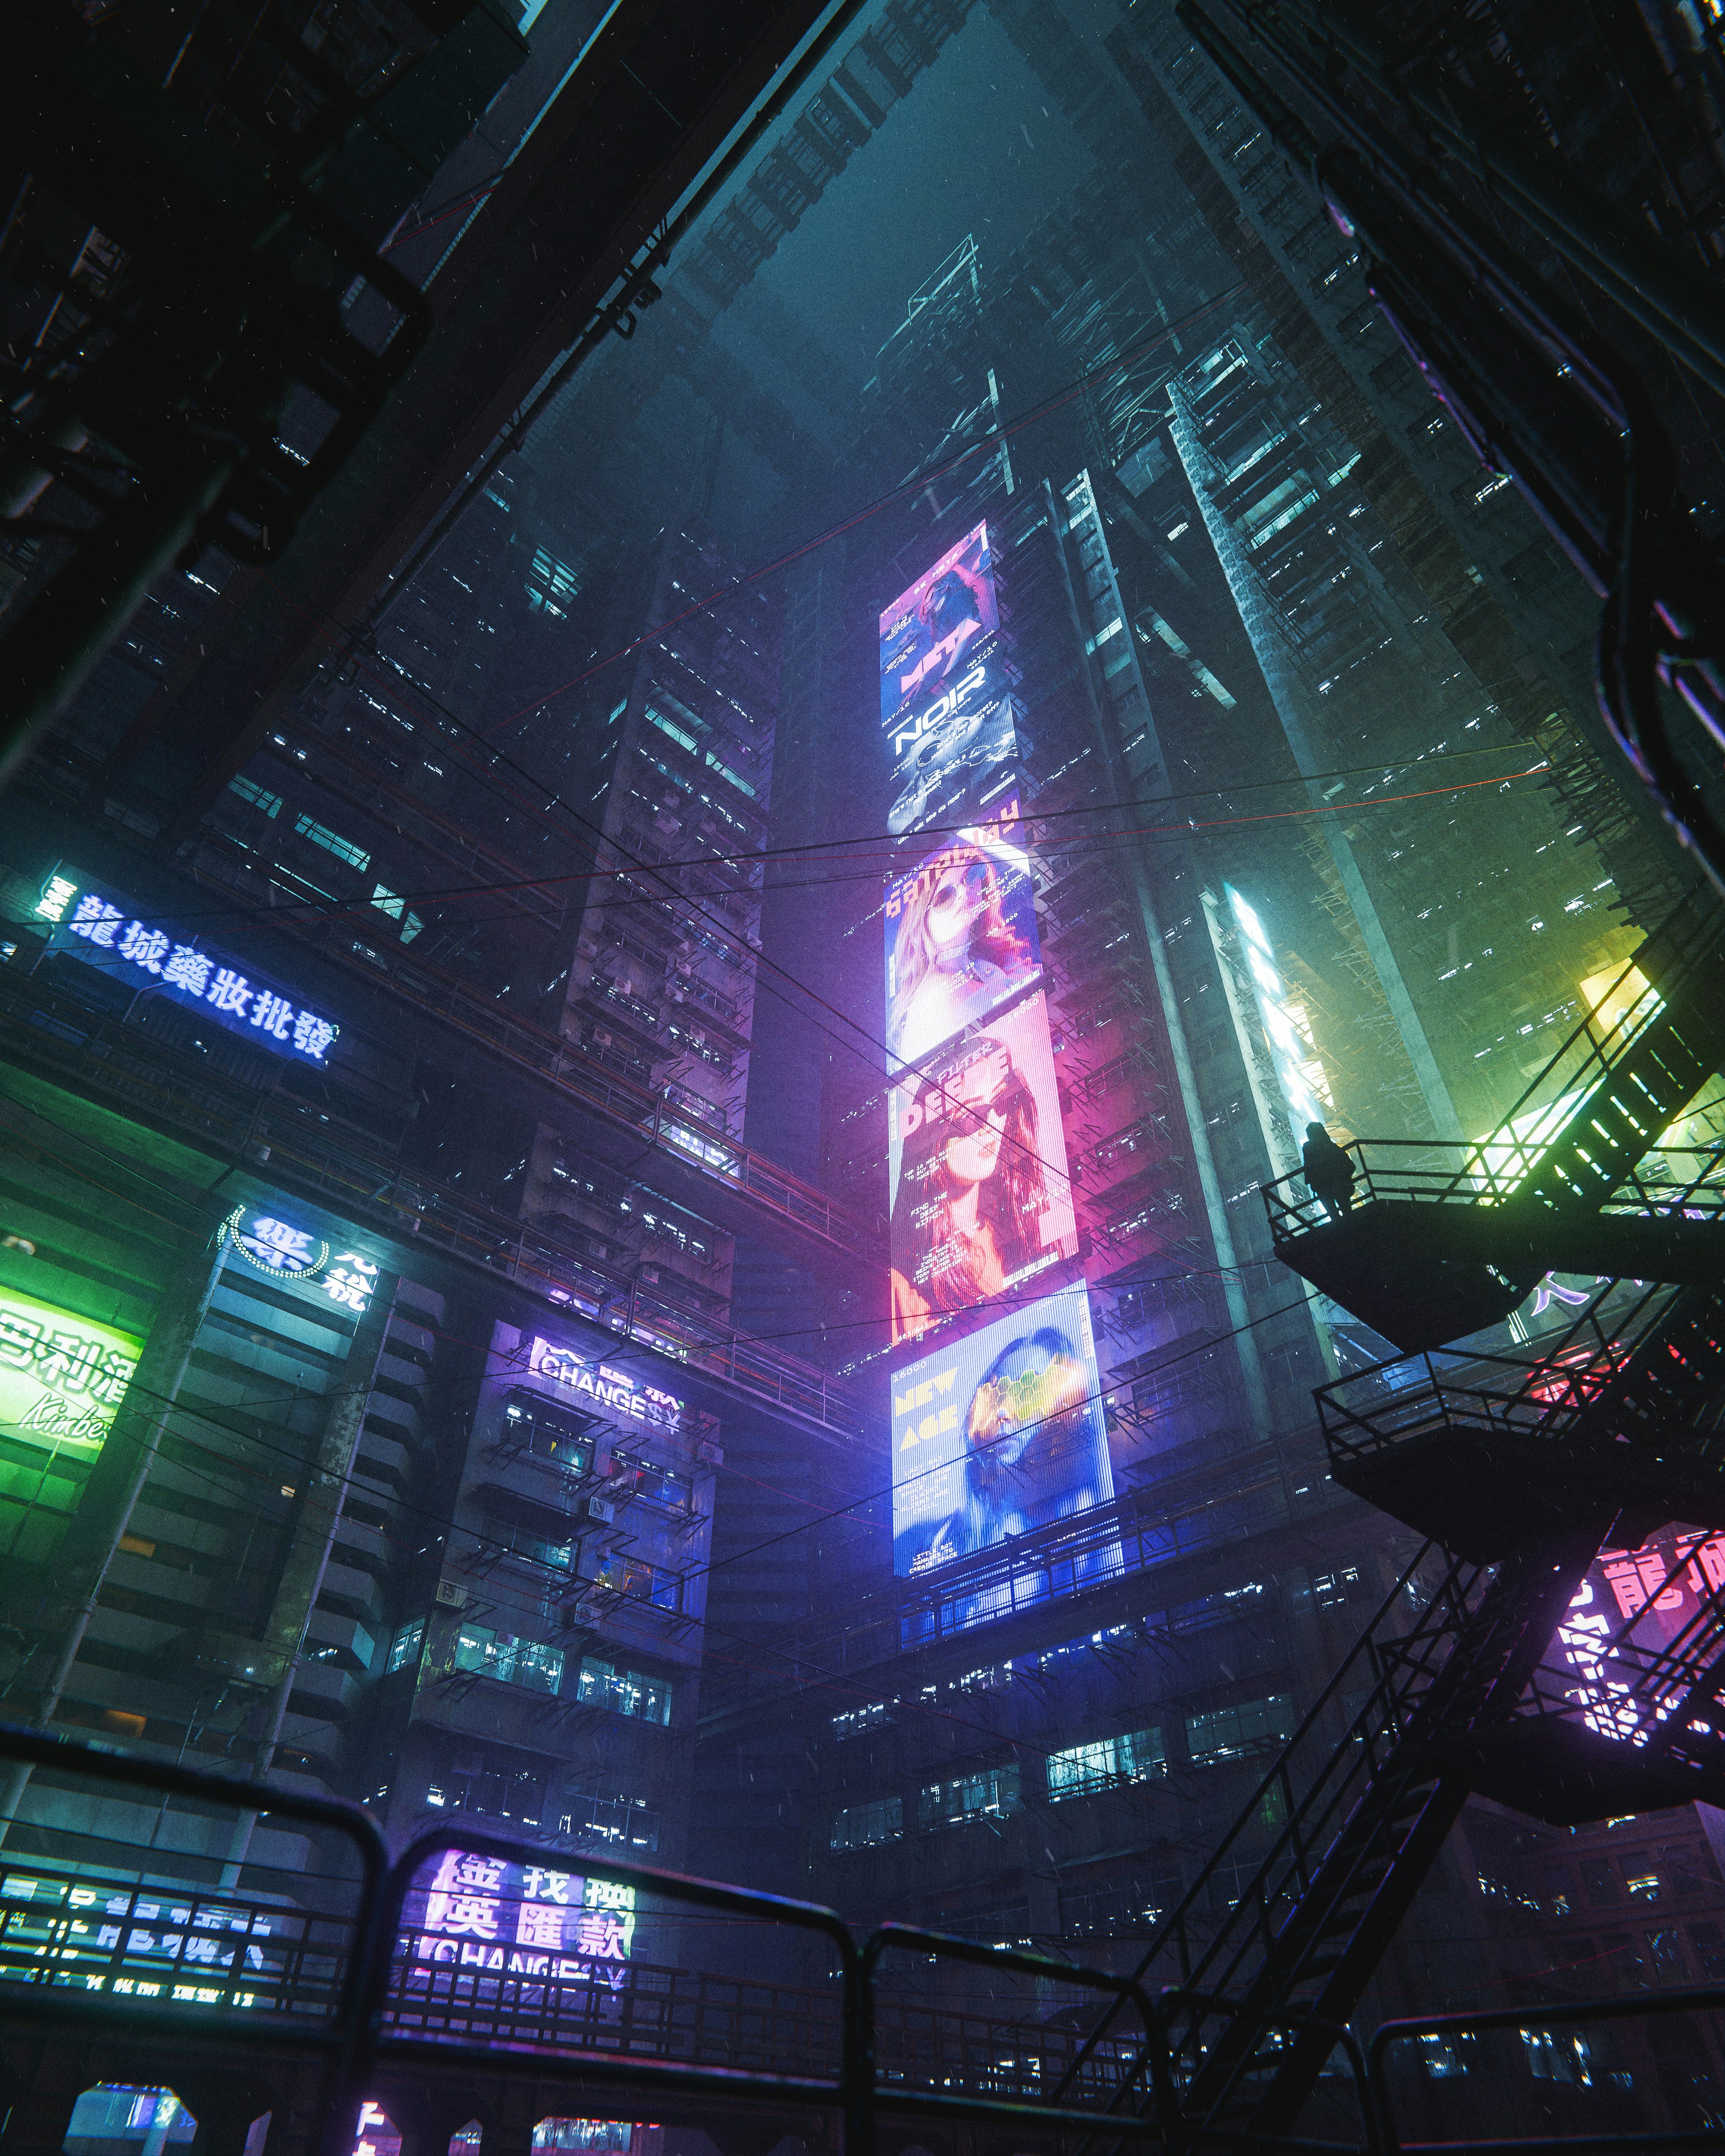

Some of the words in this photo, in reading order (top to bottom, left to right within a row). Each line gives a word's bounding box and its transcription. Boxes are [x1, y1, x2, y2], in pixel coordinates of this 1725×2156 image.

[933, 553, 957, 577] META
[967, 641, 997, 669] MAY/10
[882, 702, 910, 727] MAY/10
[896, 666, 986, 755] NOIR
[67, 894, 332, 1059] 龍城藥妝批發
[951, 970, 963, 980] TOP
[966, 962, 975, 971] 10
[937, 1041, 992, 1085] FILTER
[904, 1169, 914, 1178] TOP
[926, 1156, 936, 1165] NEW
[916, 1167, 926, 1176] BUY
[911, 1202, 929, 1217] FIND
[933, 1191, 947, 1203] THE
[920, 1204, 938, 1219] DEEP
[916, 1208, 944, 1229] WITHIN
[920, 1250, 948, 1268] INDUSTRY
[922, 1252, 932, 1261] THE
[913, 1270, 930, 1283] STORM
[933, 1260, 950, 1272] AFTER
[916, 1263, 933, 1276] BEING
[918, 1275, 928, 1285] NEW
[895, 1366, 958, 1417] NEW
[899, 1404, 958, 1452] AGE
[909, 1561, 932, 1574] CREATE
[937, 1551, 957, 1563] SPACE
[913, 1548, 936, 1561] LITTLE
[941, 1542, 953, 1550] BOY
[913, 1552, 941, 1566] MANAGES
